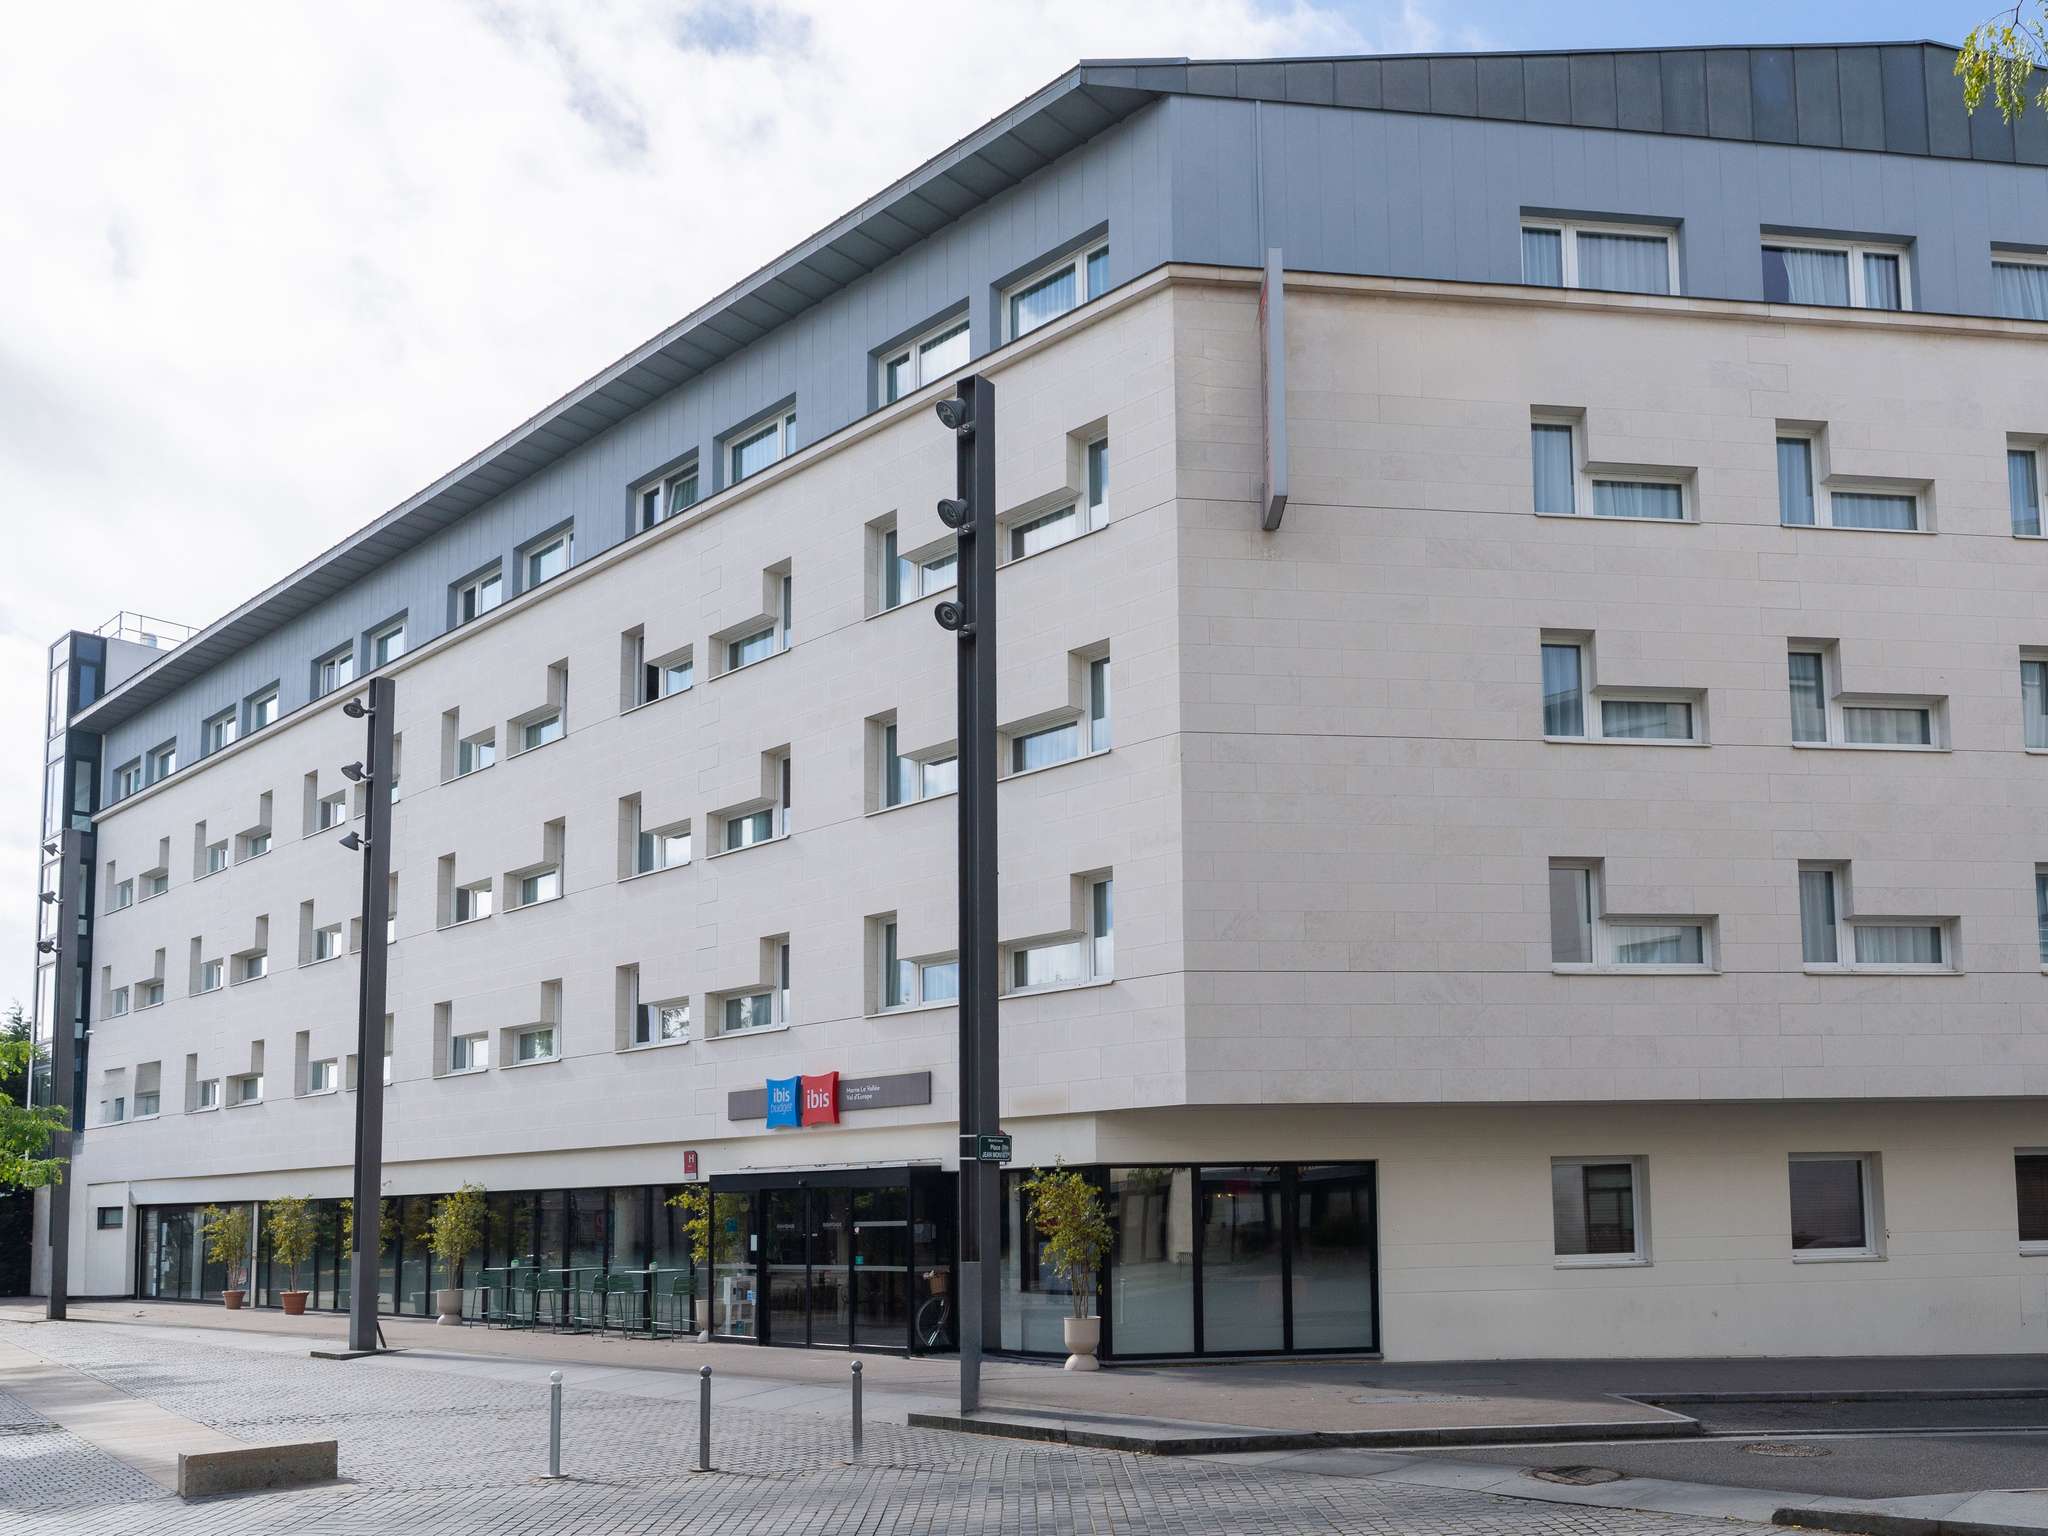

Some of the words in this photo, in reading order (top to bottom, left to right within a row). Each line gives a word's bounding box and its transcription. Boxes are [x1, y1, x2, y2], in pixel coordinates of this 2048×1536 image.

[773, 1088, 790, 1103] ibis
[807, 1088, 829, 1109] ibis
[770, 1103, 792, 1115] budget
[688, 1155, 694, 1163] H
